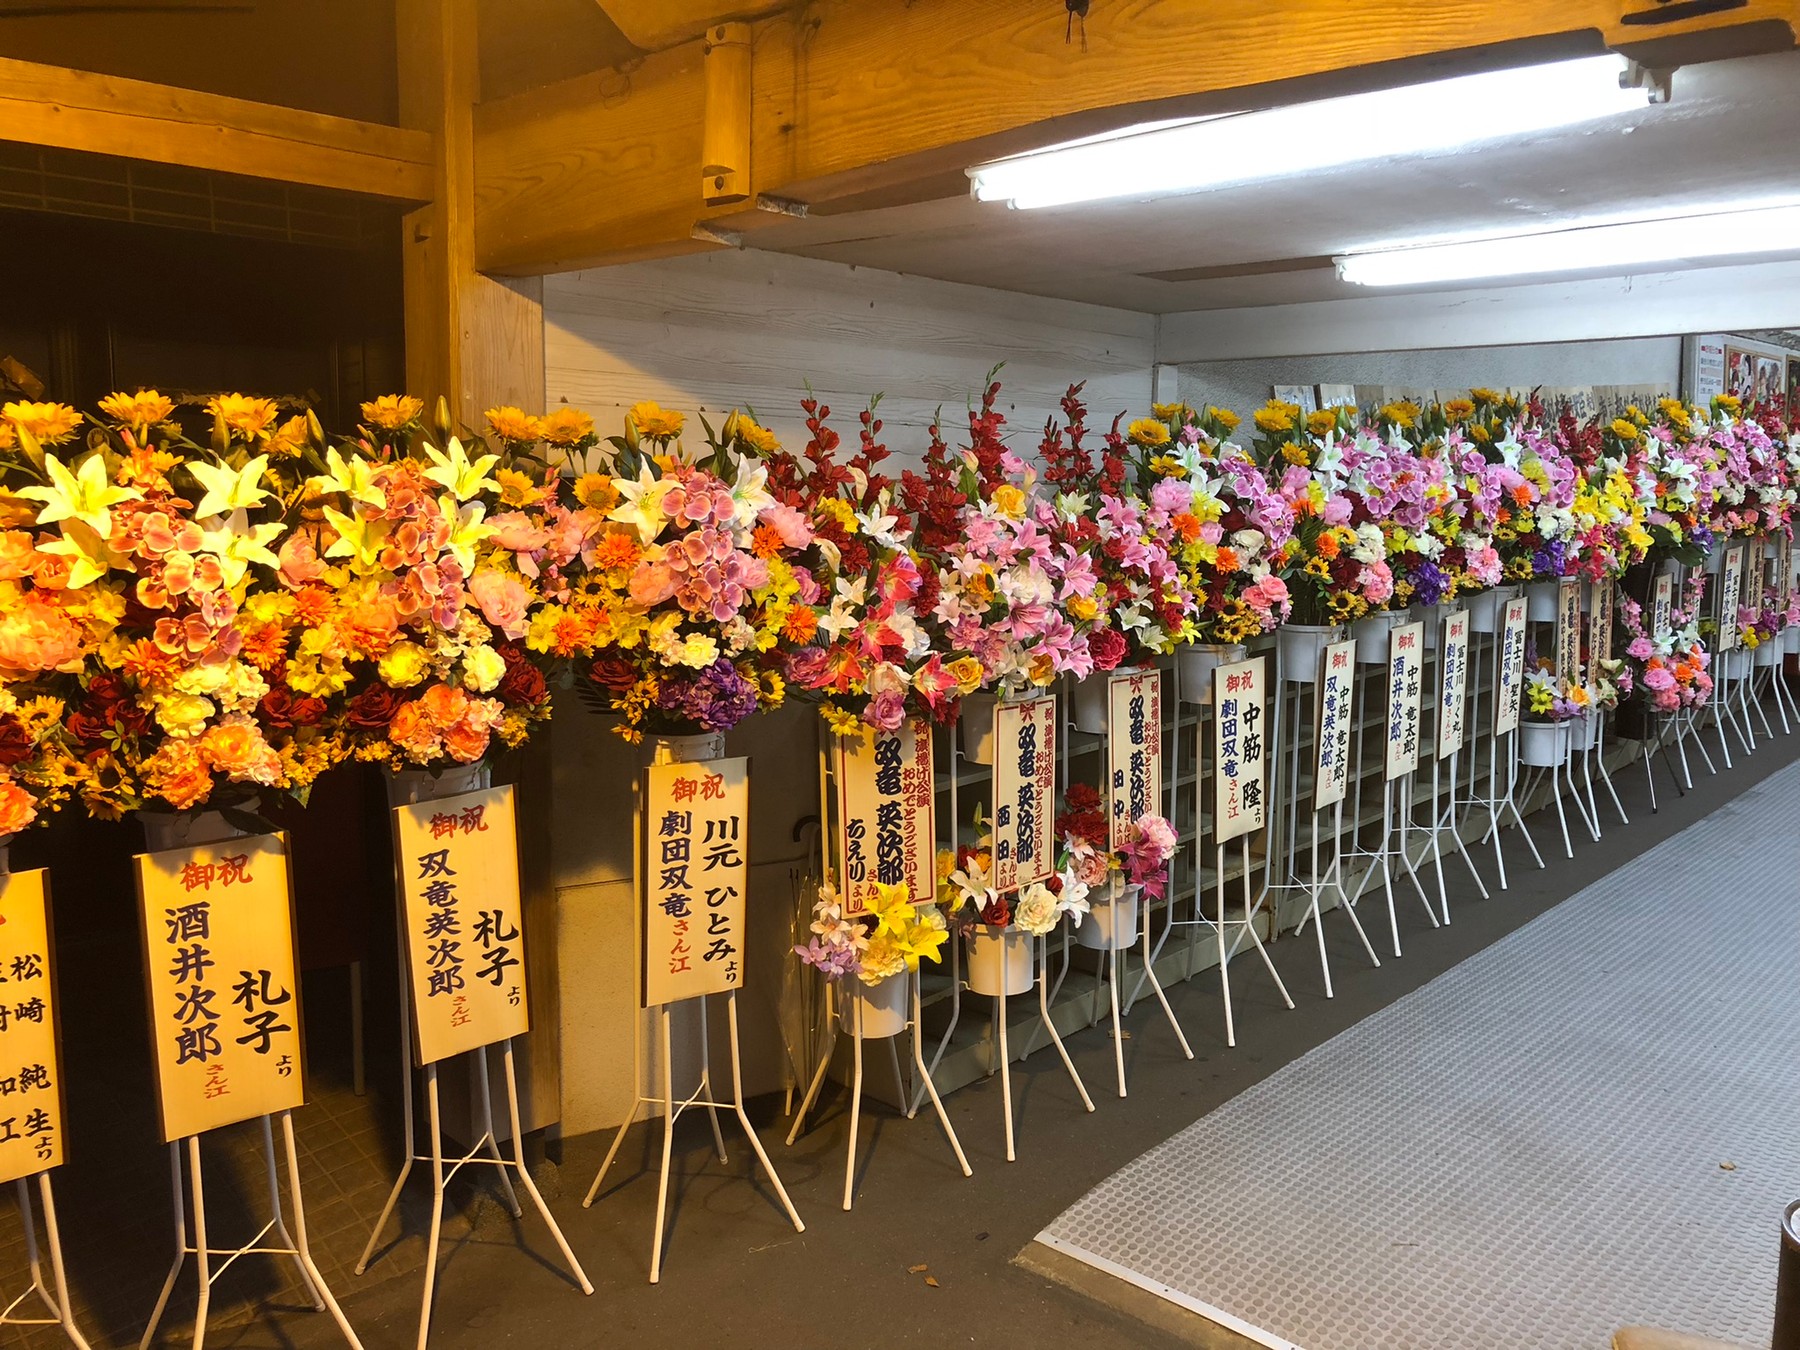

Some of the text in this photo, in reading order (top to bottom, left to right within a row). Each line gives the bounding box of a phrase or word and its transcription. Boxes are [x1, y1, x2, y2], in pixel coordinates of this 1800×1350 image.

[1397, 631, 1415, 651] 御祝
[1332, 651, 1348, 670] 御祝
[1226, 670, 1254, 693] 御祝
[672, 773, 725, 802] 御祝
[429, 804, 488, 840] 御祝
[180, 854, 253, 891] 御祝
